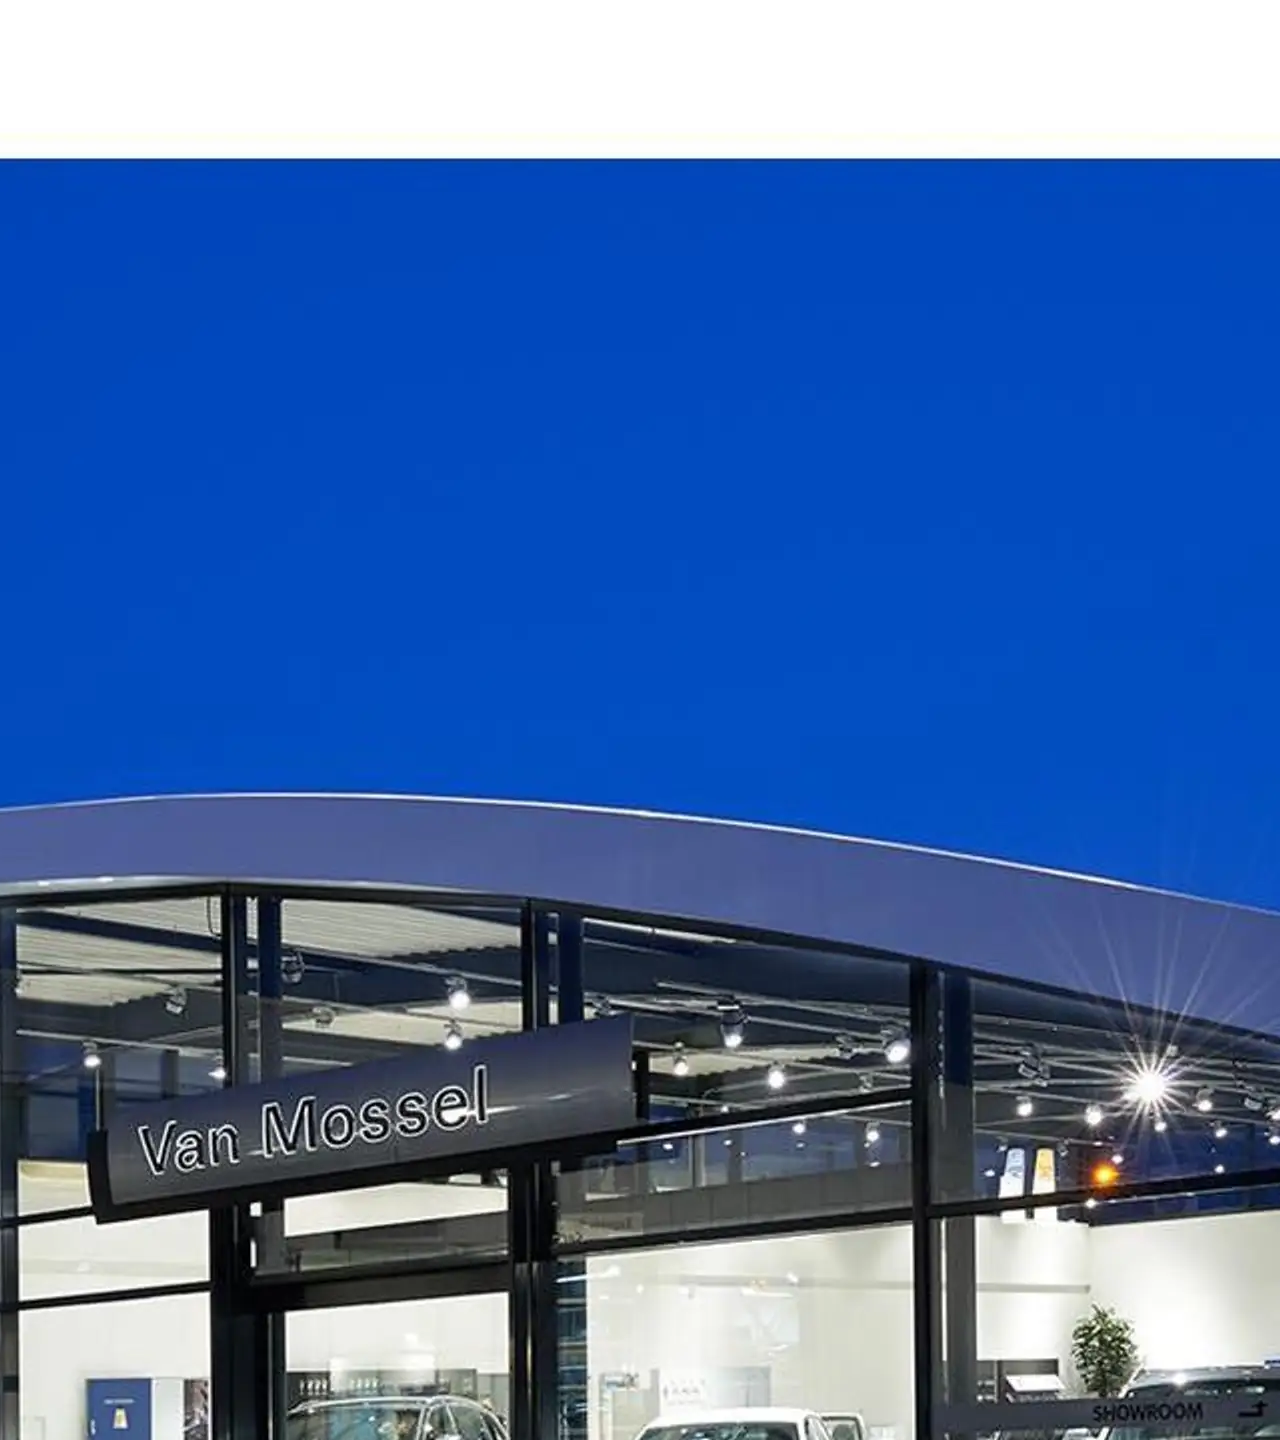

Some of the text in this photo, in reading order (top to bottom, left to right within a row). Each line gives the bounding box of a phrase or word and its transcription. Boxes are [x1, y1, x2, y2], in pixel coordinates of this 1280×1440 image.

[137, 1064, 489, 1175] Van Mossel
[1092, 1402, 1204, 1422] SHOWROOM
